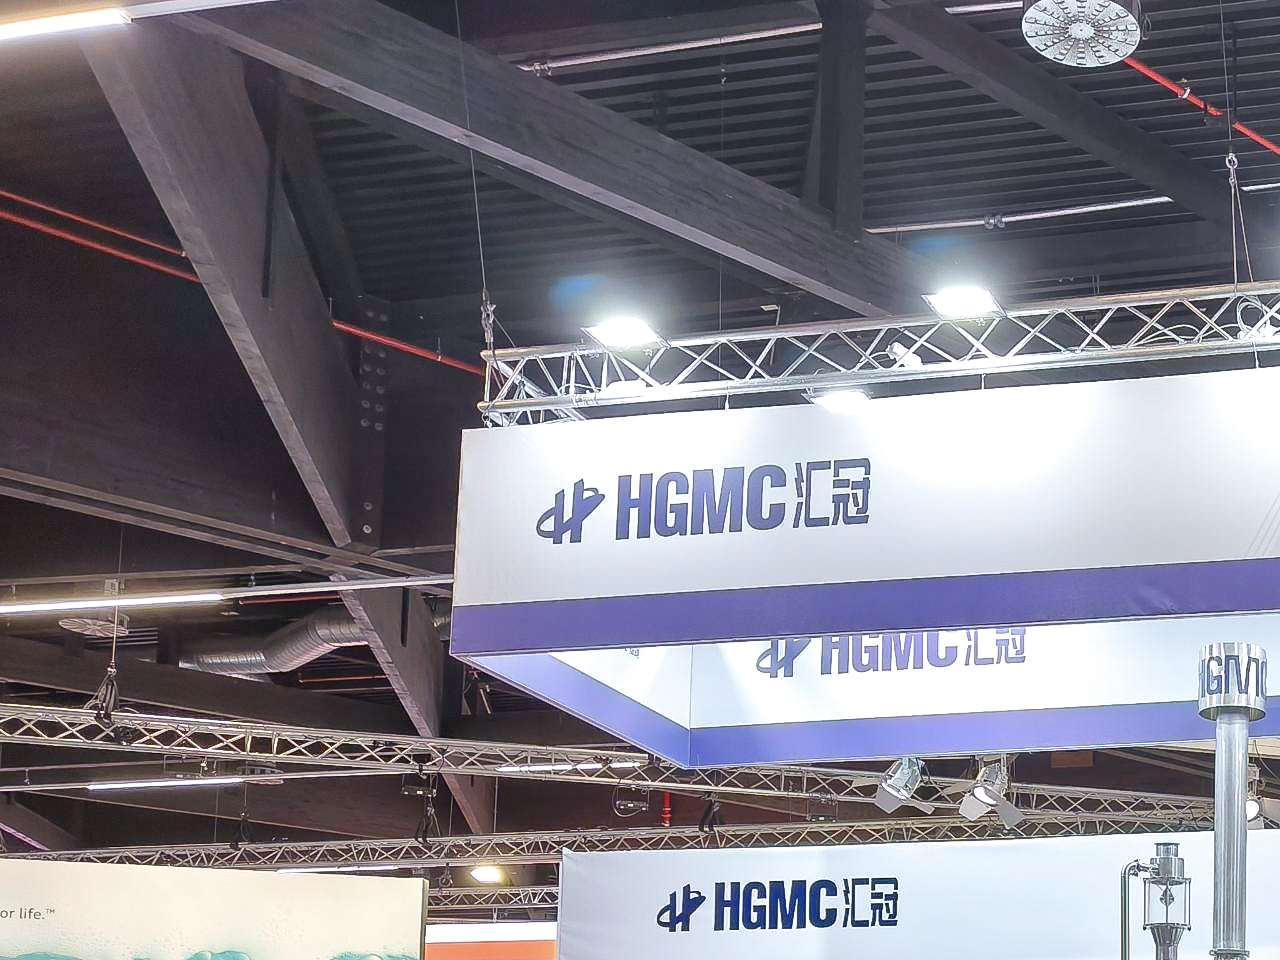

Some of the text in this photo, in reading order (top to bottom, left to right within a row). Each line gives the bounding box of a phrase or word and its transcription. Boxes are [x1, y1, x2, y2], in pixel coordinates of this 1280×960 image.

[615, 458, 871, 540] HGMC 汇冠
[821, 631, 958, 675] HGMC
[714, 877, 899, 931] HGMC 汇冠
